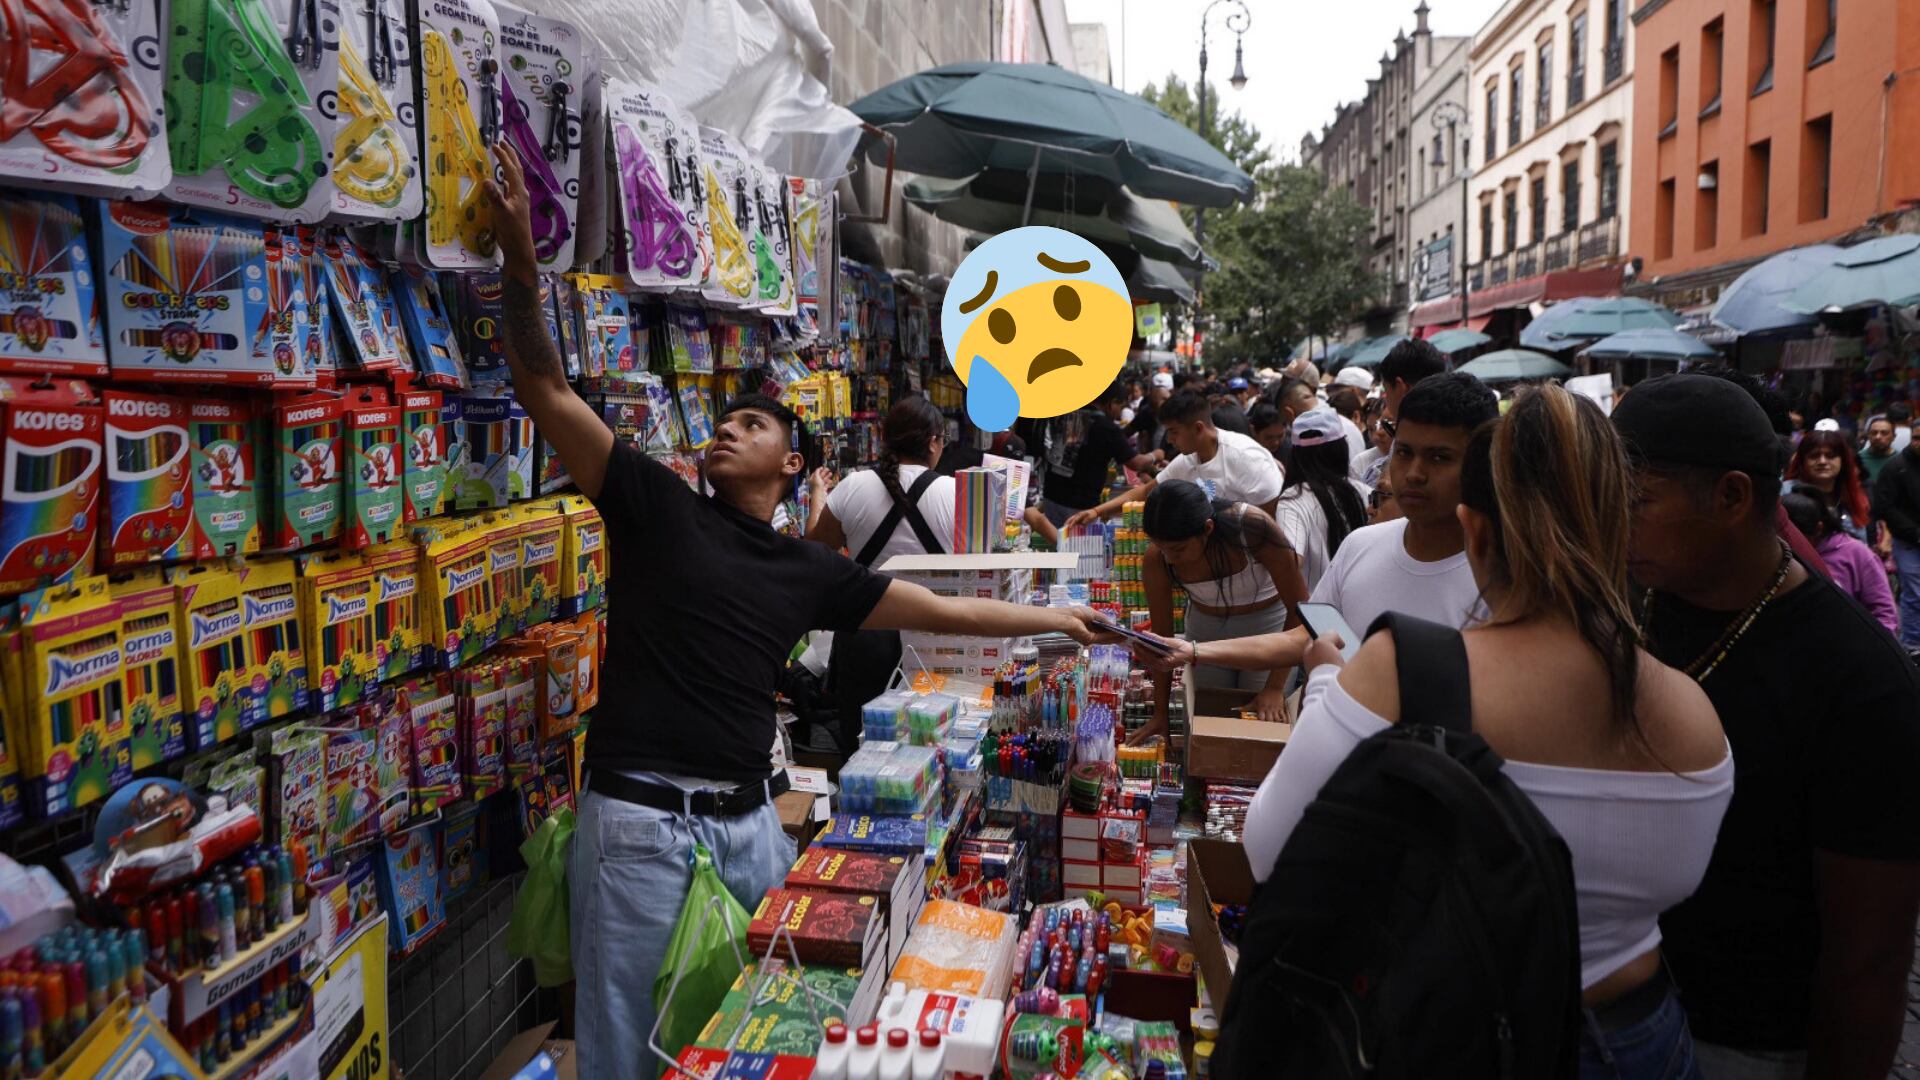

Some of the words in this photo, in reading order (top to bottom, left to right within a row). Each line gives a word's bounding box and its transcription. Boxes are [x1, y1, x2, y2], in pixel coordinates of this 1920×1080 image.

[434, 3, 487, 28] GEOMETRÍA
[526, 30, 540, 40] DE
[501, 36, 562, 57] EOMETRÍA
[42, 153, 60, 173] 5
[226, 185, 240, 205] 5
[337, 191, 348, 209] 5
[460, 248, 468, 263] 5
[160, 309, 201, 319] STRONG
[491, 551, 516, 569] Norma
[525, 543, 554, 564] Norma
[381, 576, 415, 599] Norma
[449, 566, 483, 592] Norma
[244, 596, 294, 625] Norma
[329, 598, 366, 621] Norma
[191, 613, 240, 646] Norma
[125, 630, 173, 653] orma
[125, 649, 163, 665] OLORES
[47, 649, 120, 694] Norma
[242, 697, 253, 709] 15
[170, 721, 183, 736] 15
[116, 749, 130, 764] 15
[819, 852, 848, 881] Escolar
[785, 895, 813, 931] Escolar
[206, 958, 265, 1006] Gomas
[270, 929, 307, 964] Push
